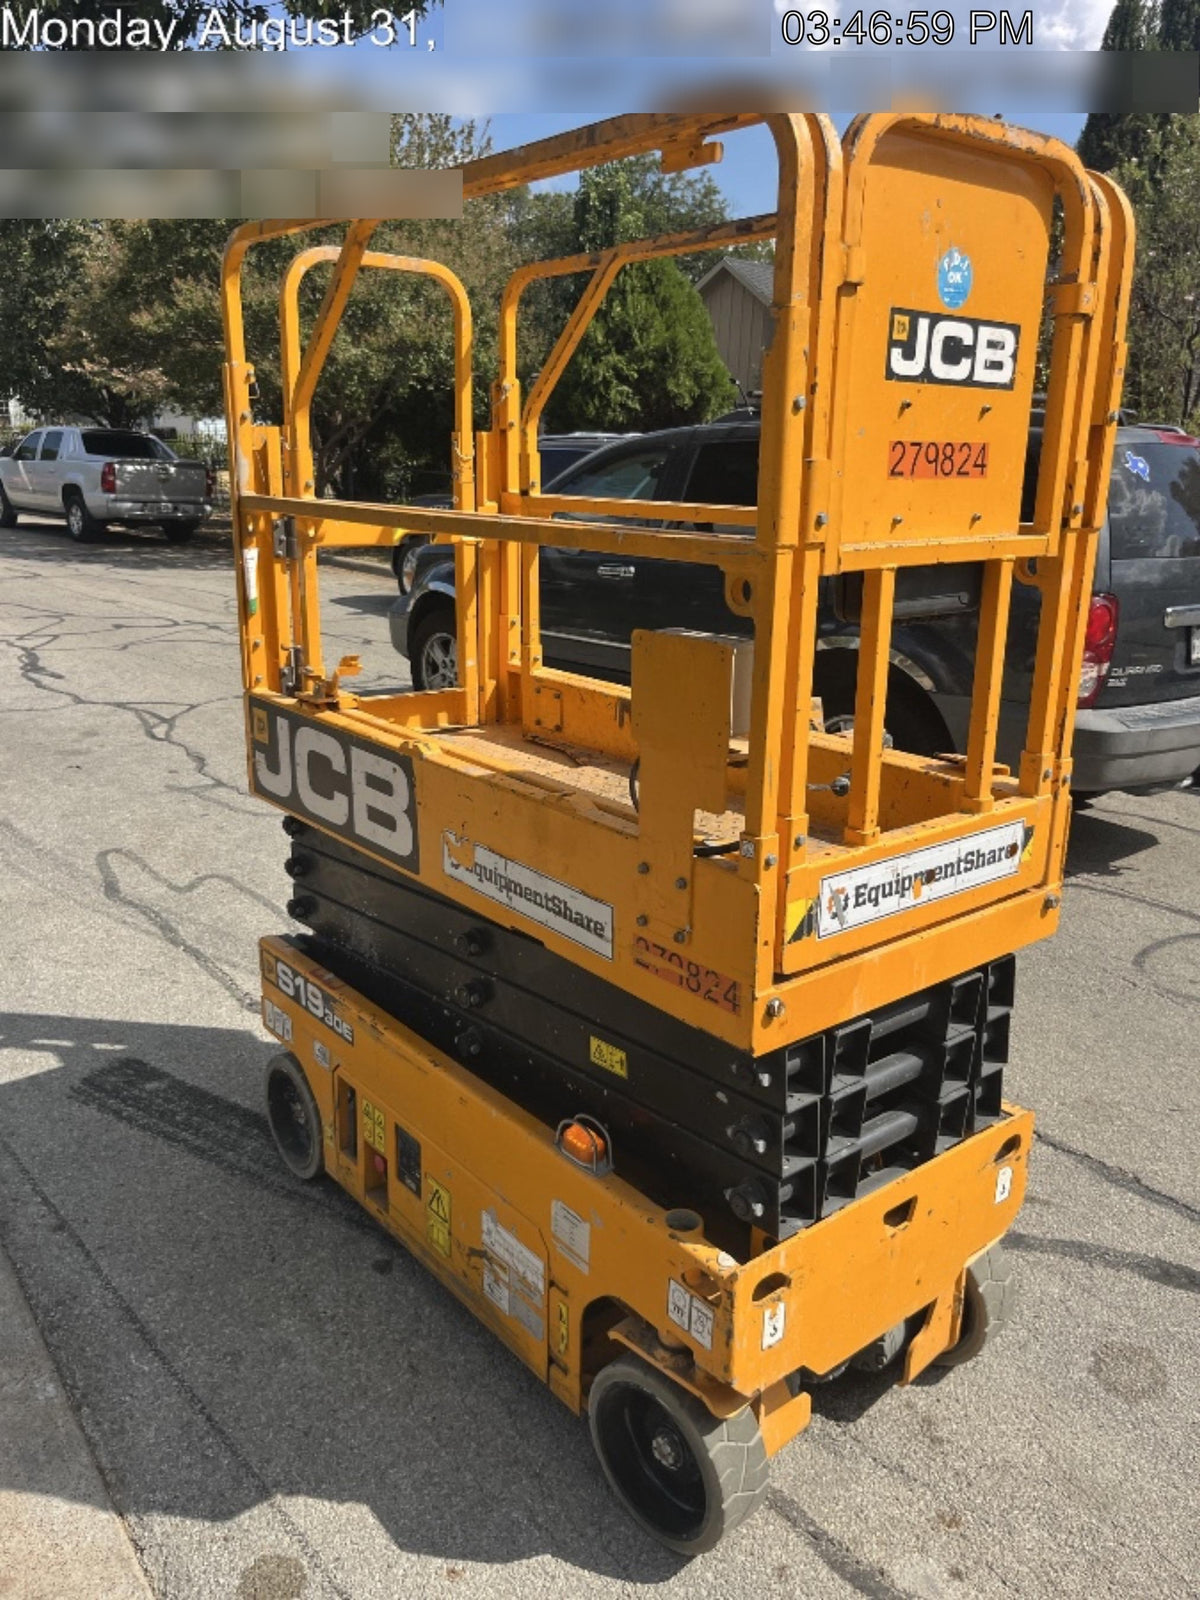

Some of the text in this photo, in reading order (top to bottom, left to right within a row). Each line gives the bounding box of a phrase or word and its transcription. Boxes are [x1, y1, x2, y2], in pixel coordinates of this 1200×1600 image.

[890, 317, 1016, 383] JCB
[890, 441, 987, 477] 279824
[255, 716, 413, 857] JCB
[465, 859, 606, 938] quipmentShare
